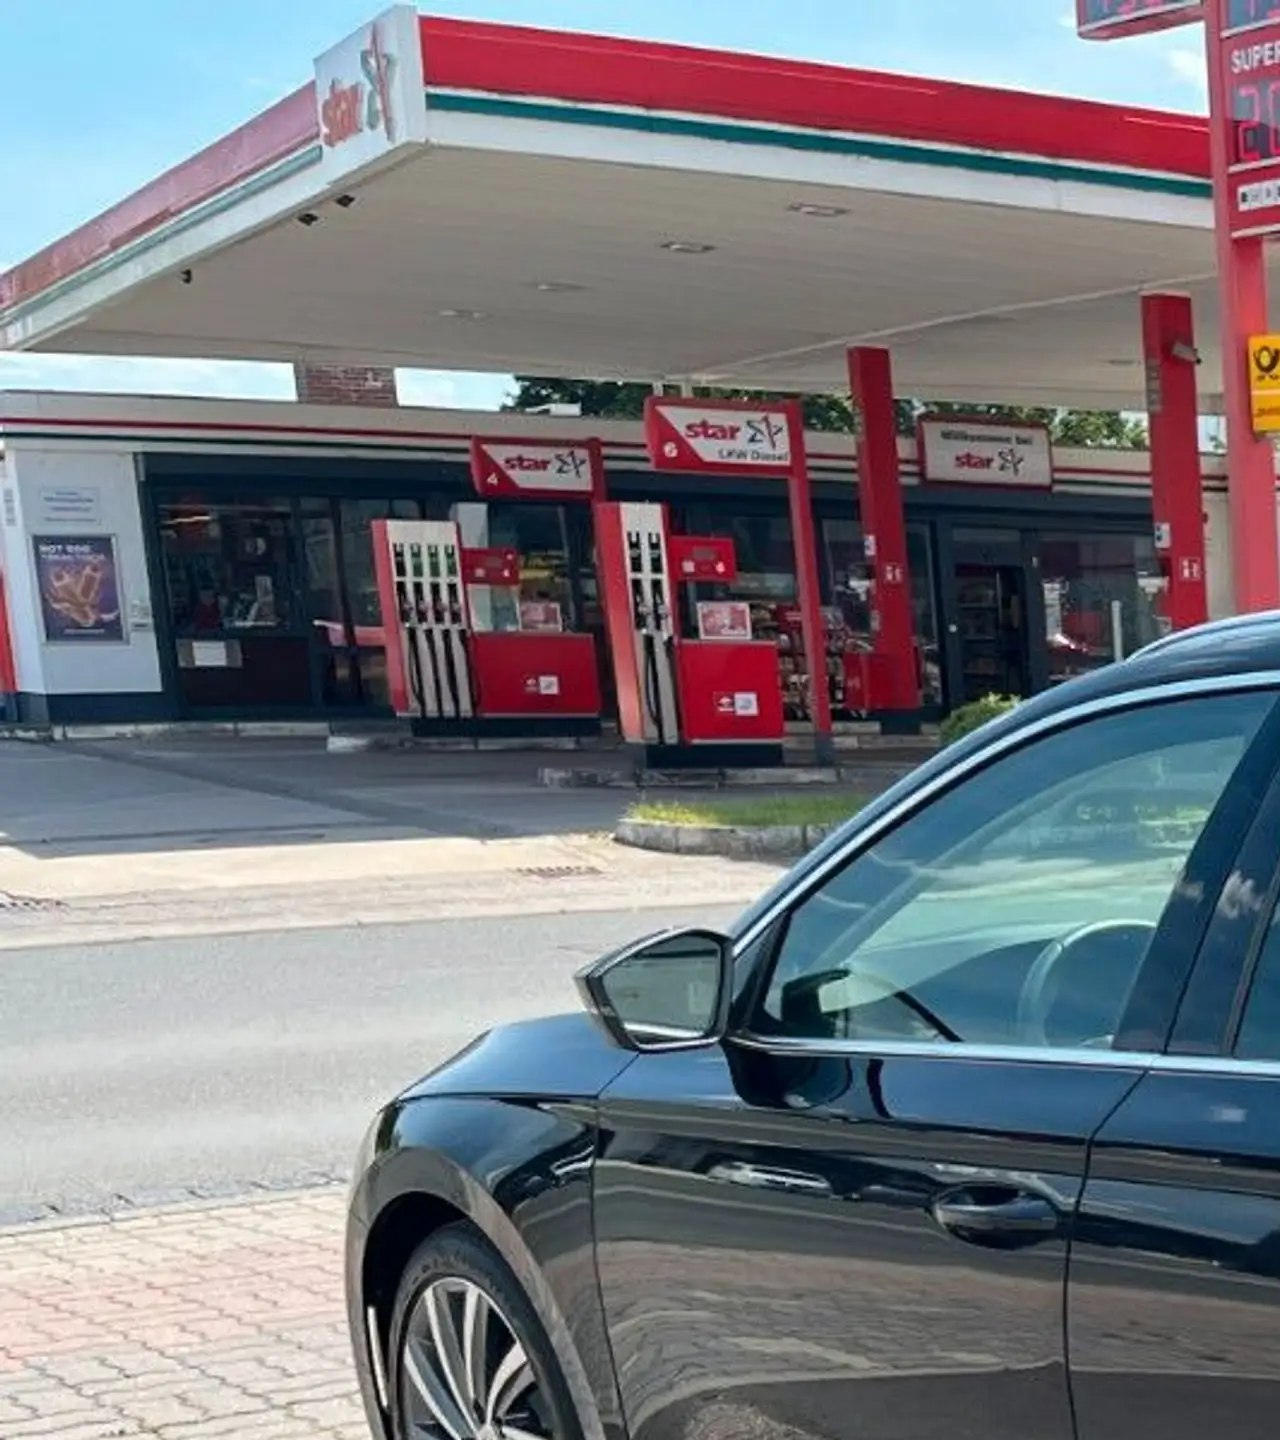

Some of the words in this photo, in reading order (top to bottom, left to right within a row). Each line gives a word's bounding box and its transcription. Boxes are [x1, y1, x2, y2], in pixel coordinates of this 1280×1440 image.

[685, 418, 741, 441] star
[504, 453, 550, 473] star
[954, 451, 994, 469] star
